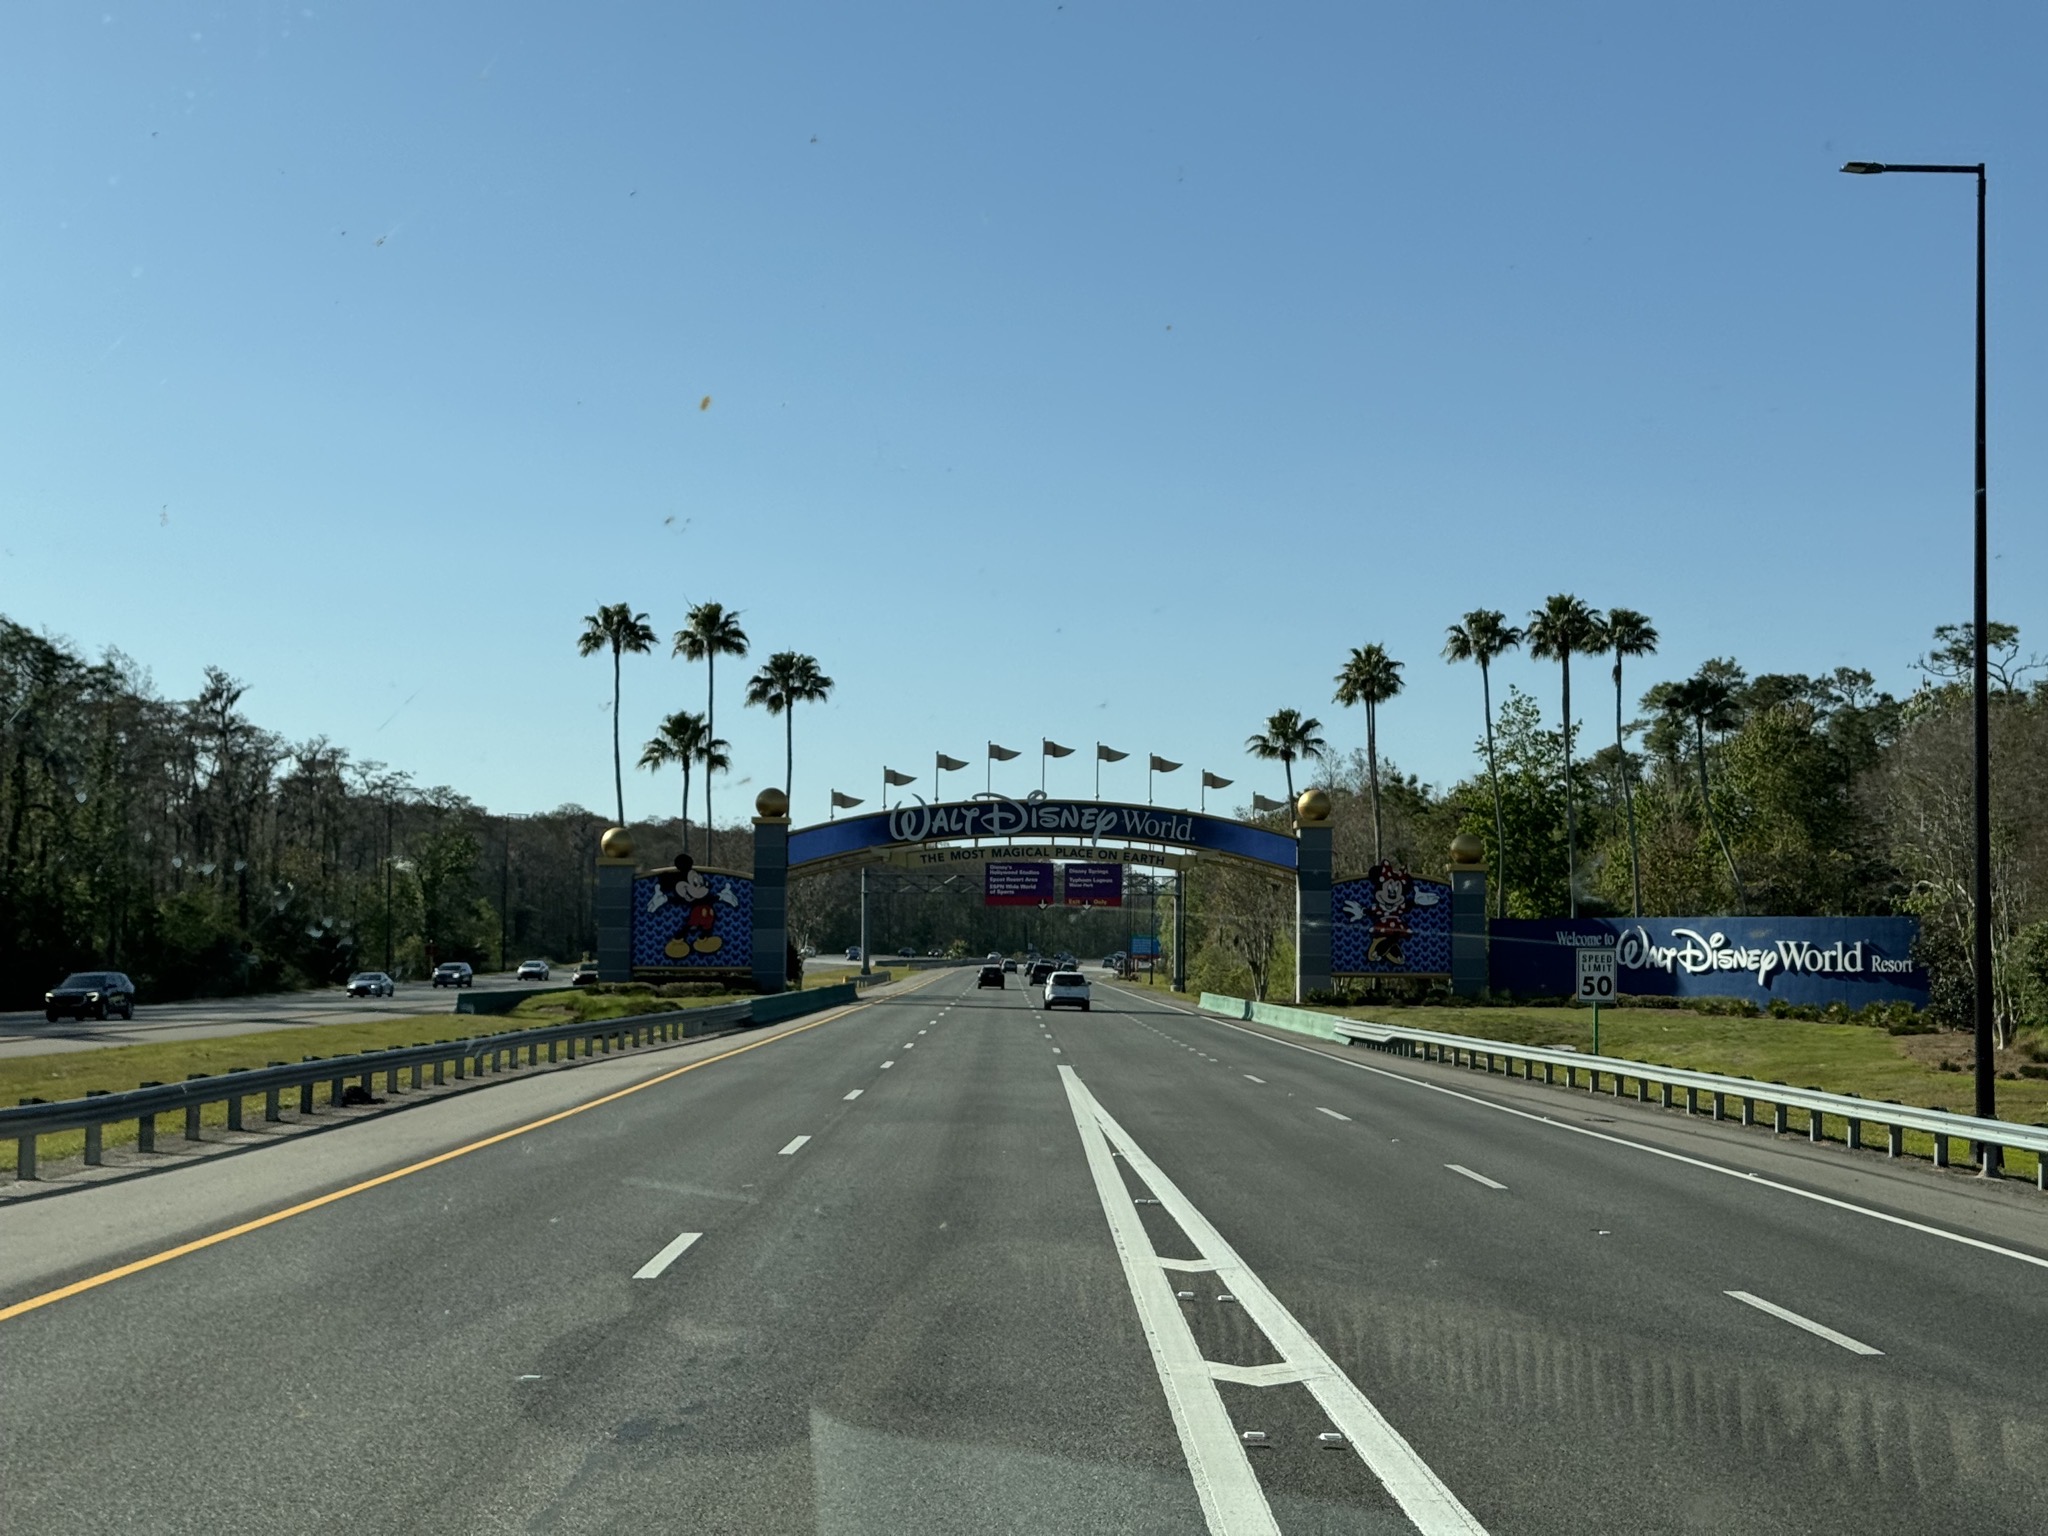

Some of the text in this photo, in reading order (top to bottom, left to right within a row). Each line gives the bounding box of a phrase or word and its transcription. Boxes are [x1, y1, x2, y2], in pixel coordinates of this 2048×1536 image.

[920, 847, 1165, 866] THE MOST MAGICAL PLACE ON EARTH
[1556, 931, 1602, 946] Welcome
[1604, 932, 1615, 946] to
[1774, 940, 1864, 973] World
[1871, 955, 1913, 973] Resort
[1581, 954, 1613, 963] SPEED
[1581, 963, 1613, 972] LIMIT
[1581, 976, 1613, 996] 50
